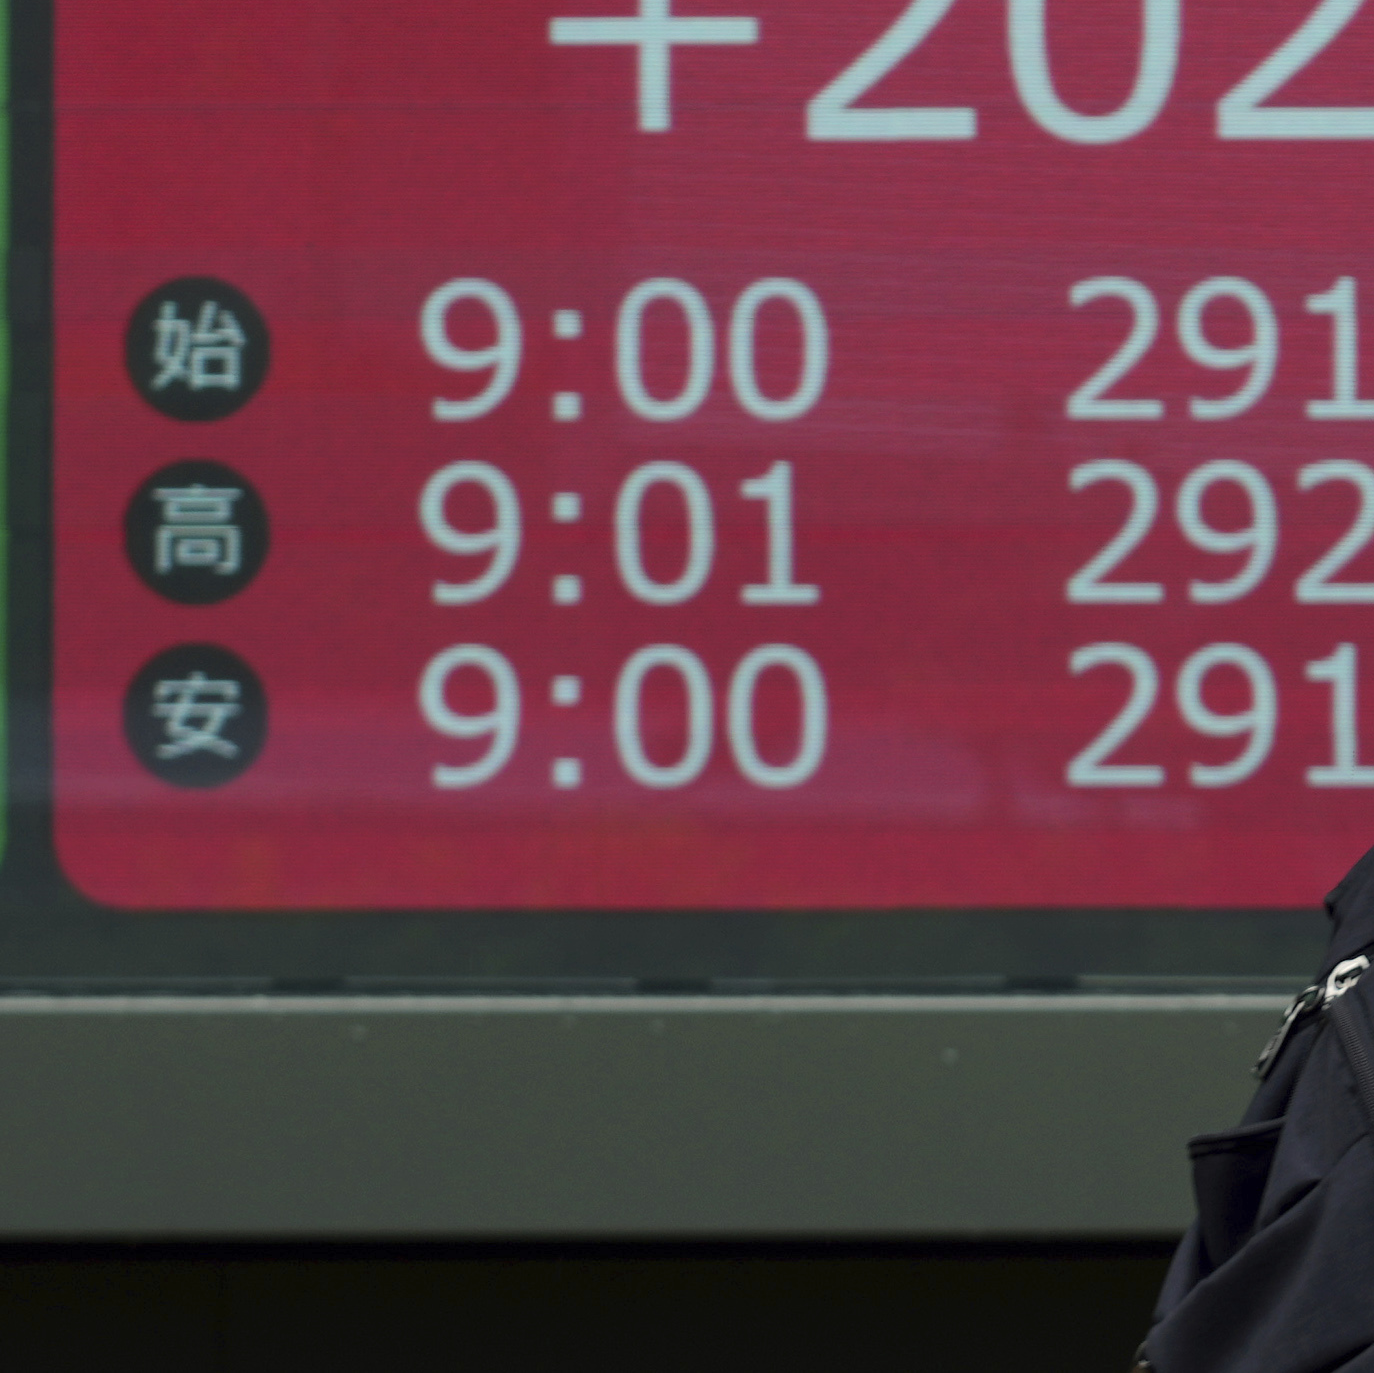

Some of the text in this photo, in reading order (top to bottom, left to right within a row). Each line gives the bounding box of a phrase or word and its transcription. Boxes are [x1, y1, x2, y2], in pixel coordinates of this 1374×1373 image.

[152, 301, 246, 391] 始
[420, 277, 829, 422] 9:00
[154, 484, 242, 575] 高
[418, 461, 820, 605] 9:01
[153, 673, 241, 760] 安
[418, 644, 828, 789] 9:00
